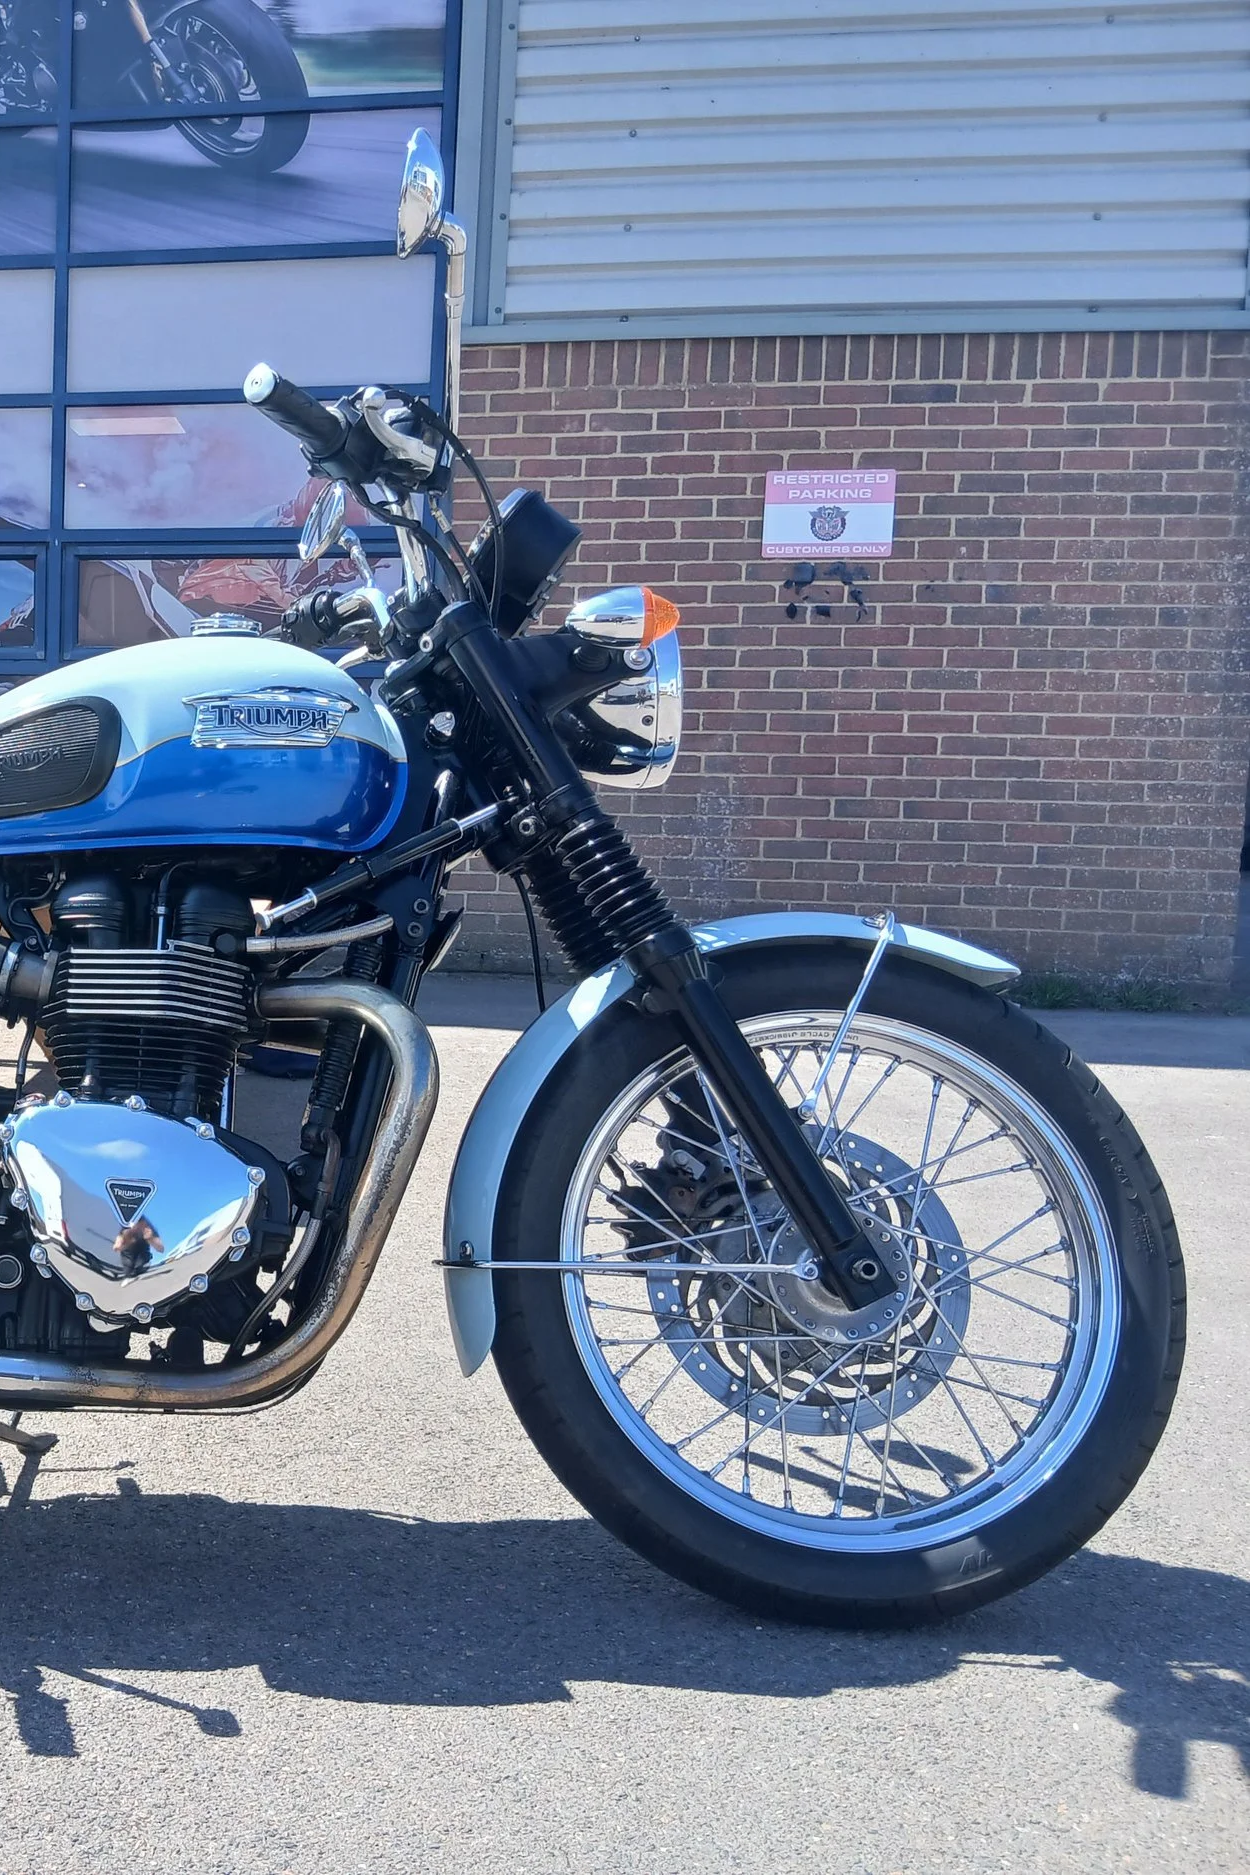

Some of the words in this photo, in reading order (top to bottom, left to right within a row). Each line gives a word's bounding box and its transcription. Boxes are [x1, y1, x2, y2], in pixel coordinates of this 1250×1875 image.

[773, 473, 889, 485] RESTRICTED
[788, 488, 872, 500] PARKING
[766, 545, 850, 554] CUSTOMERS
[852, 545, 887, 554] ONLY
[210, 704, 329, 737] TRIUMPH
[114, 1187, 146, 1200] TRIUMPH
